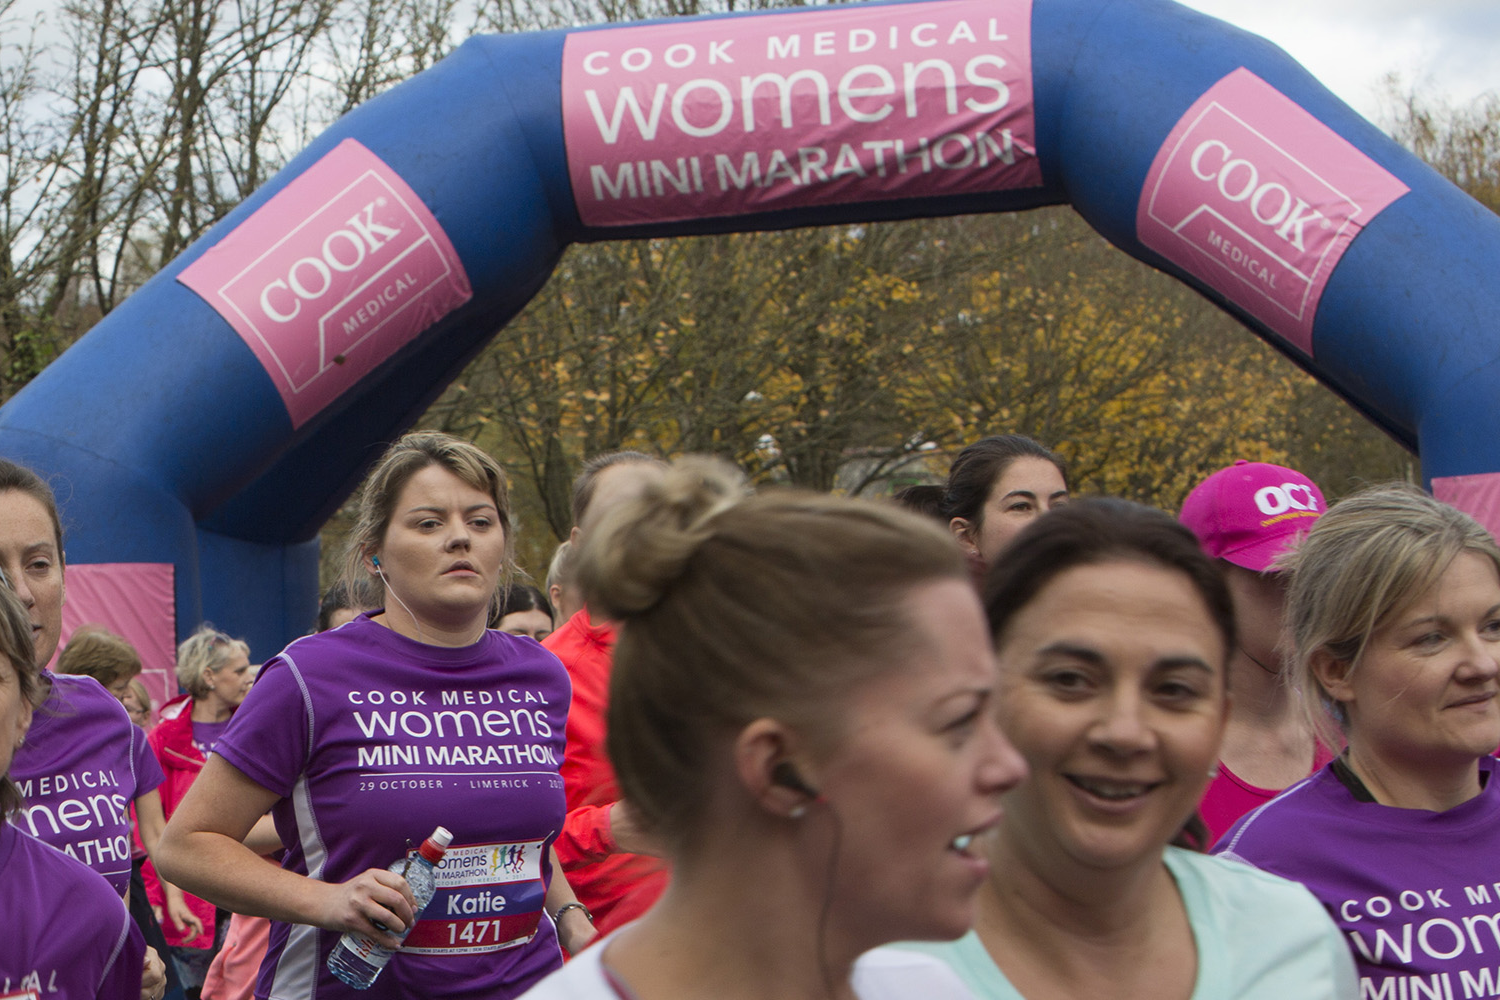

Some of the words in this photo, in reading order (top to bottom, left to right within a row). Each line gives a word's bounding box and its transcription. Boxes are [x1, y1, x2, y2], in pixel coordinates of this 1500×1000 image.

[582, 39, 735, 76] COOK
[767, 18, 1009, 60] MEDICAL
[584, 54, 1010, 145] womens
[590, 156, 705, 201] MINI
[715, 128, 1016, 192] MARATHON
[1190, 139, 1324, 253] COOK
[260, 201, 401, 323] COOK
[1207, 230, 1277, 289] MEDICAL
[342, 272, 418, 335] MEDICAL
[348, 690, 427, 705] COOK
[441, 689, 549, 706] MEDICAL
[353, 708, 552, 738] womens
[358, 745, 420, 767] MINI
[425, 744, 559, 766] MARATHON
[15, 771, 119, 798] MEDICAL
[359, 782, 375, 791] 29
[379, 780, 444, 790] OCTOBER
[469, 779, 529, 789] LIMERICK
[437, 854, 488, 870] omens
[453, 847, 488, 856] MEDICAL
[441, 868, 488, 880] MARATHON
[447, 890, 507, 915] Katie
[1341, 888, 1451, 922] COOK
[447, 920, 501, 945] 1471
